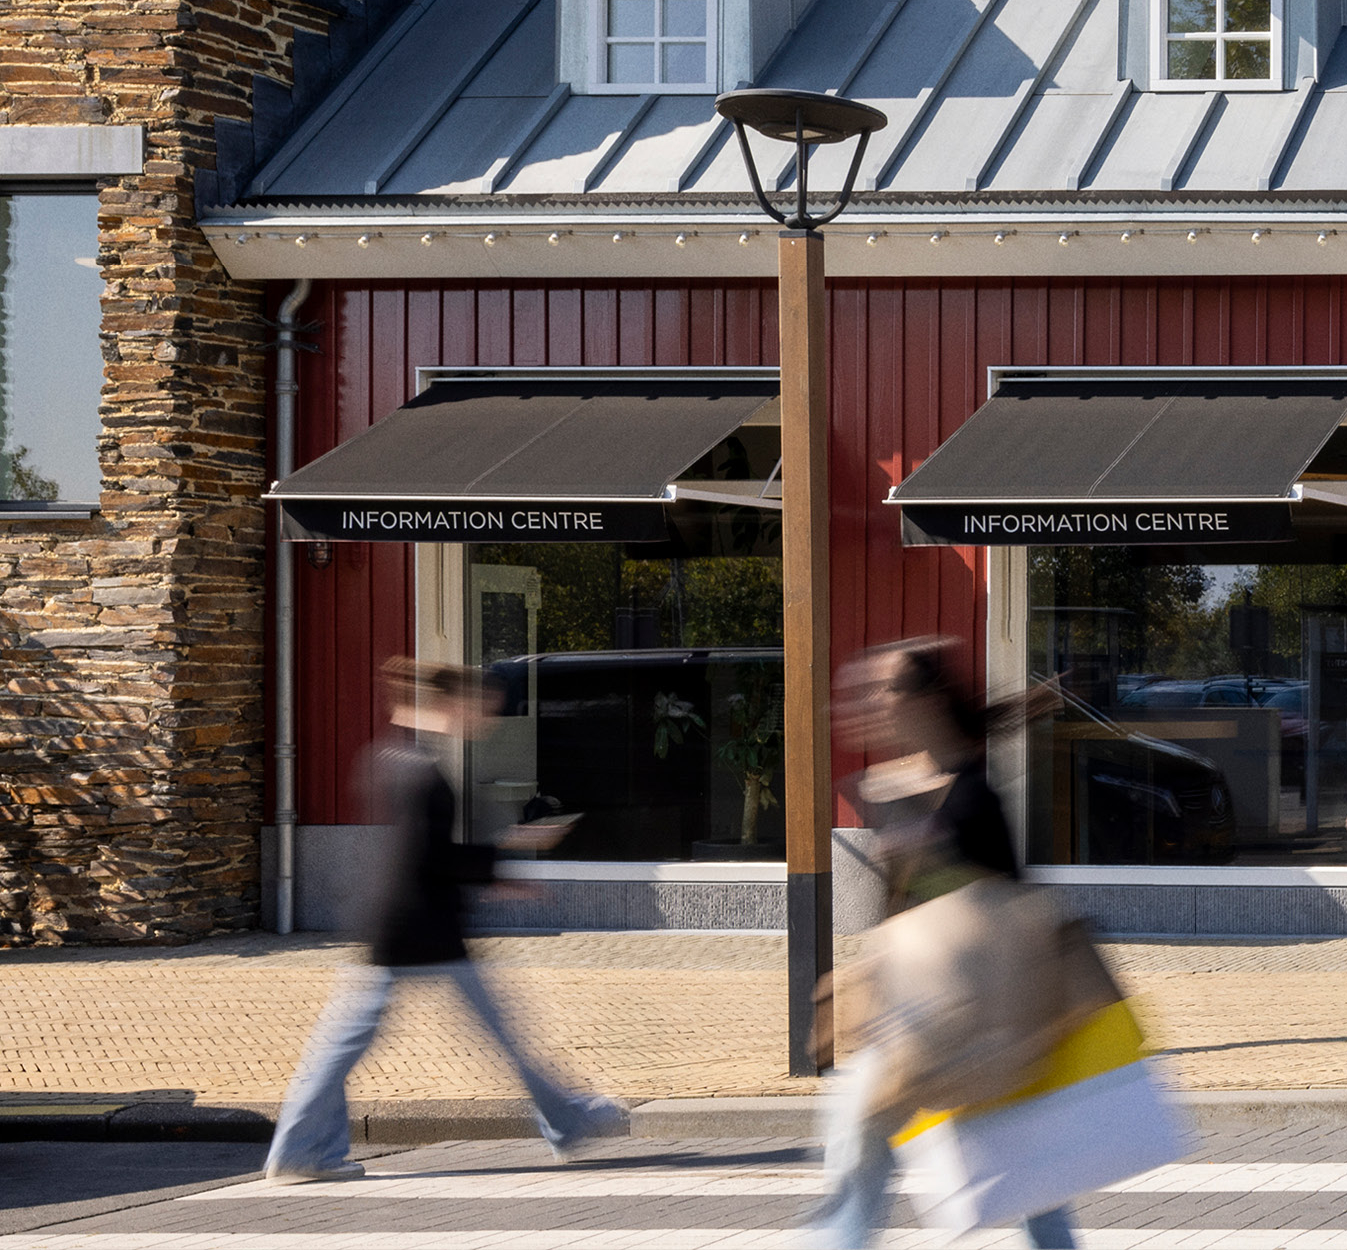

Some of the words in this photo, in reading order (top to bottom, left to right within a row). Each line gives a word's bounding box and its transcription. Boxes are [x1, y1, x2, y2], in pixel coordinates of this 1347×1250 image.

[342, 511, 504, 530] INFORMATION
[511, 511, 604, 530] CENTRE
[964, 513, 1128, 534] INFORMATION
[1135, 512, 1230, 531] CENTRE
